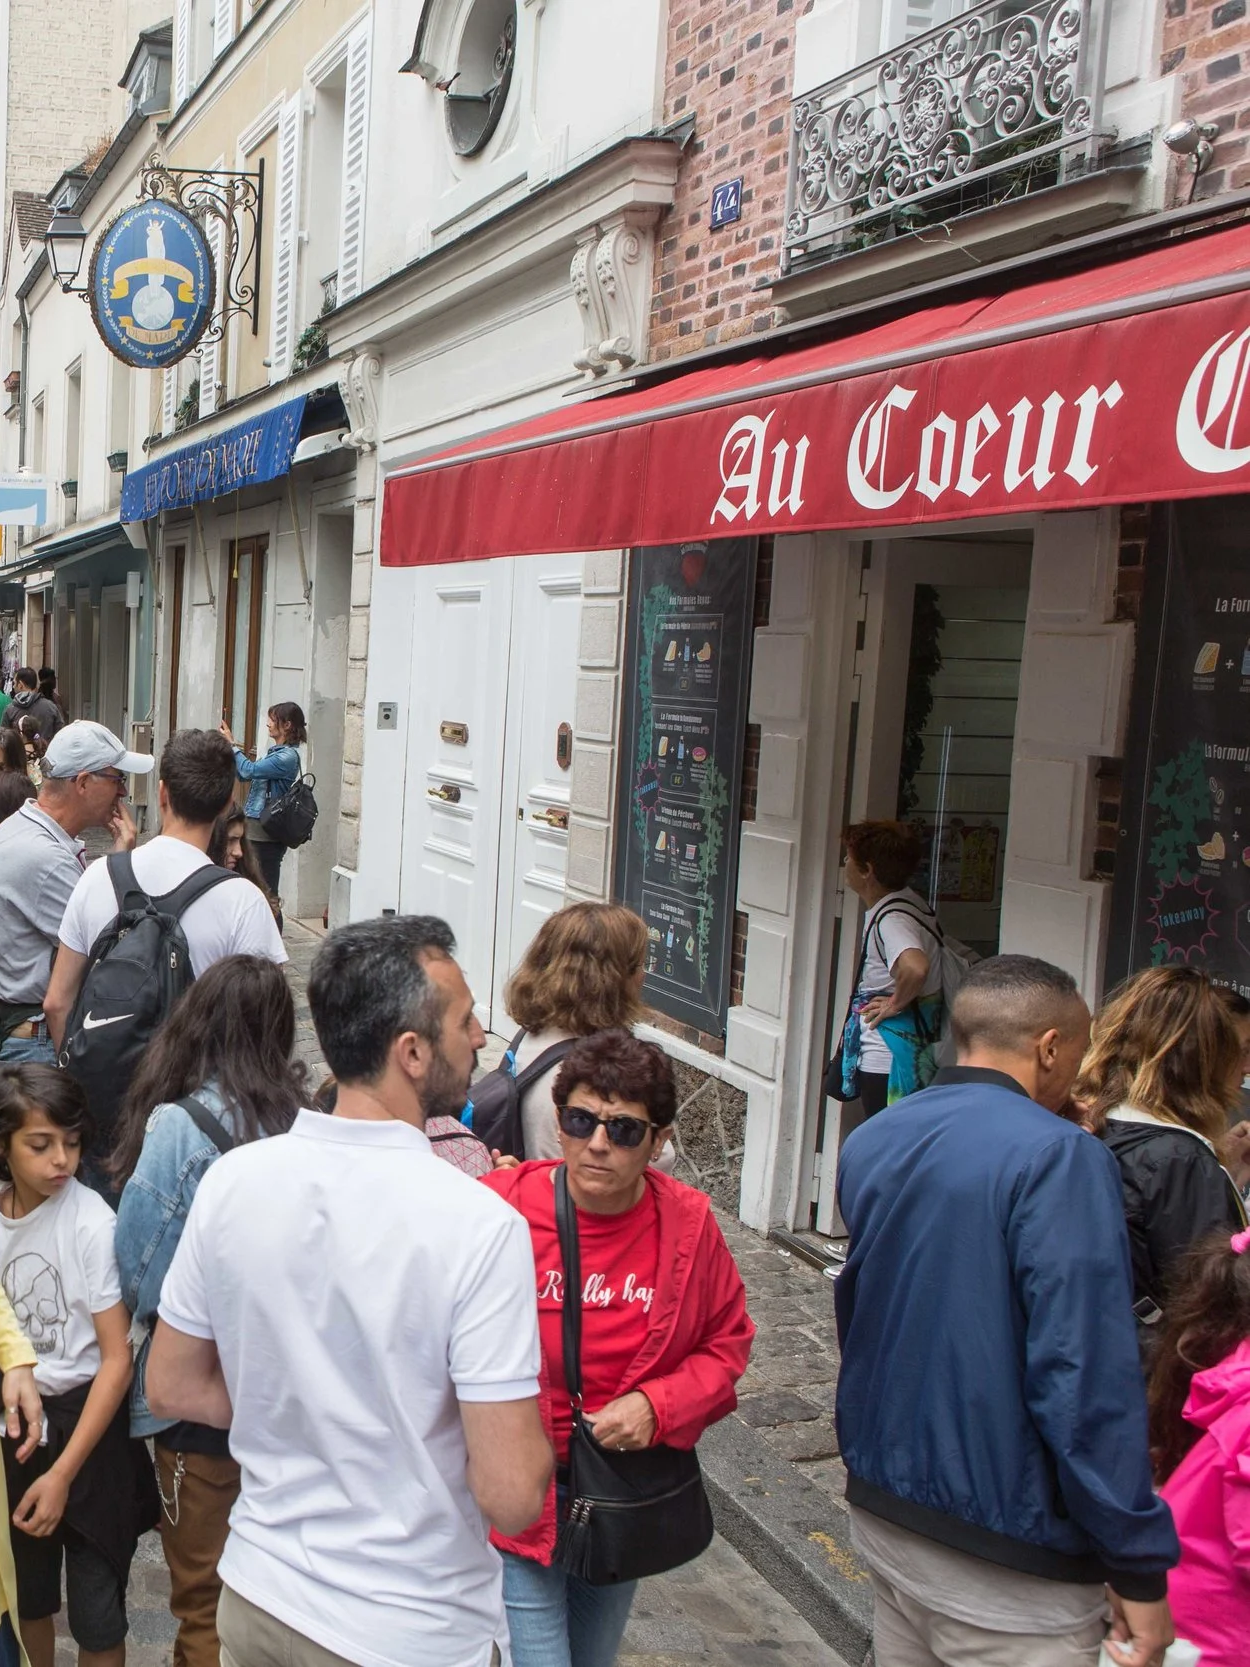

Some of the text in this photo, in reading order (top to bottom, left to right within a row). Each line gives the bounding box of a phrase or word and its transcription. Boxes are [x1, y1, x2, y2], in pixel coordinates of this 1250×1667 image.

[710, 409, 810, 525] Au
[847, 379, 1124, 510] Coeur
[1215, 597, 1227, 613] La
[1158, 906, 1206, 929] Takeaway
[537, 1270, 616, 1307] Rlly
